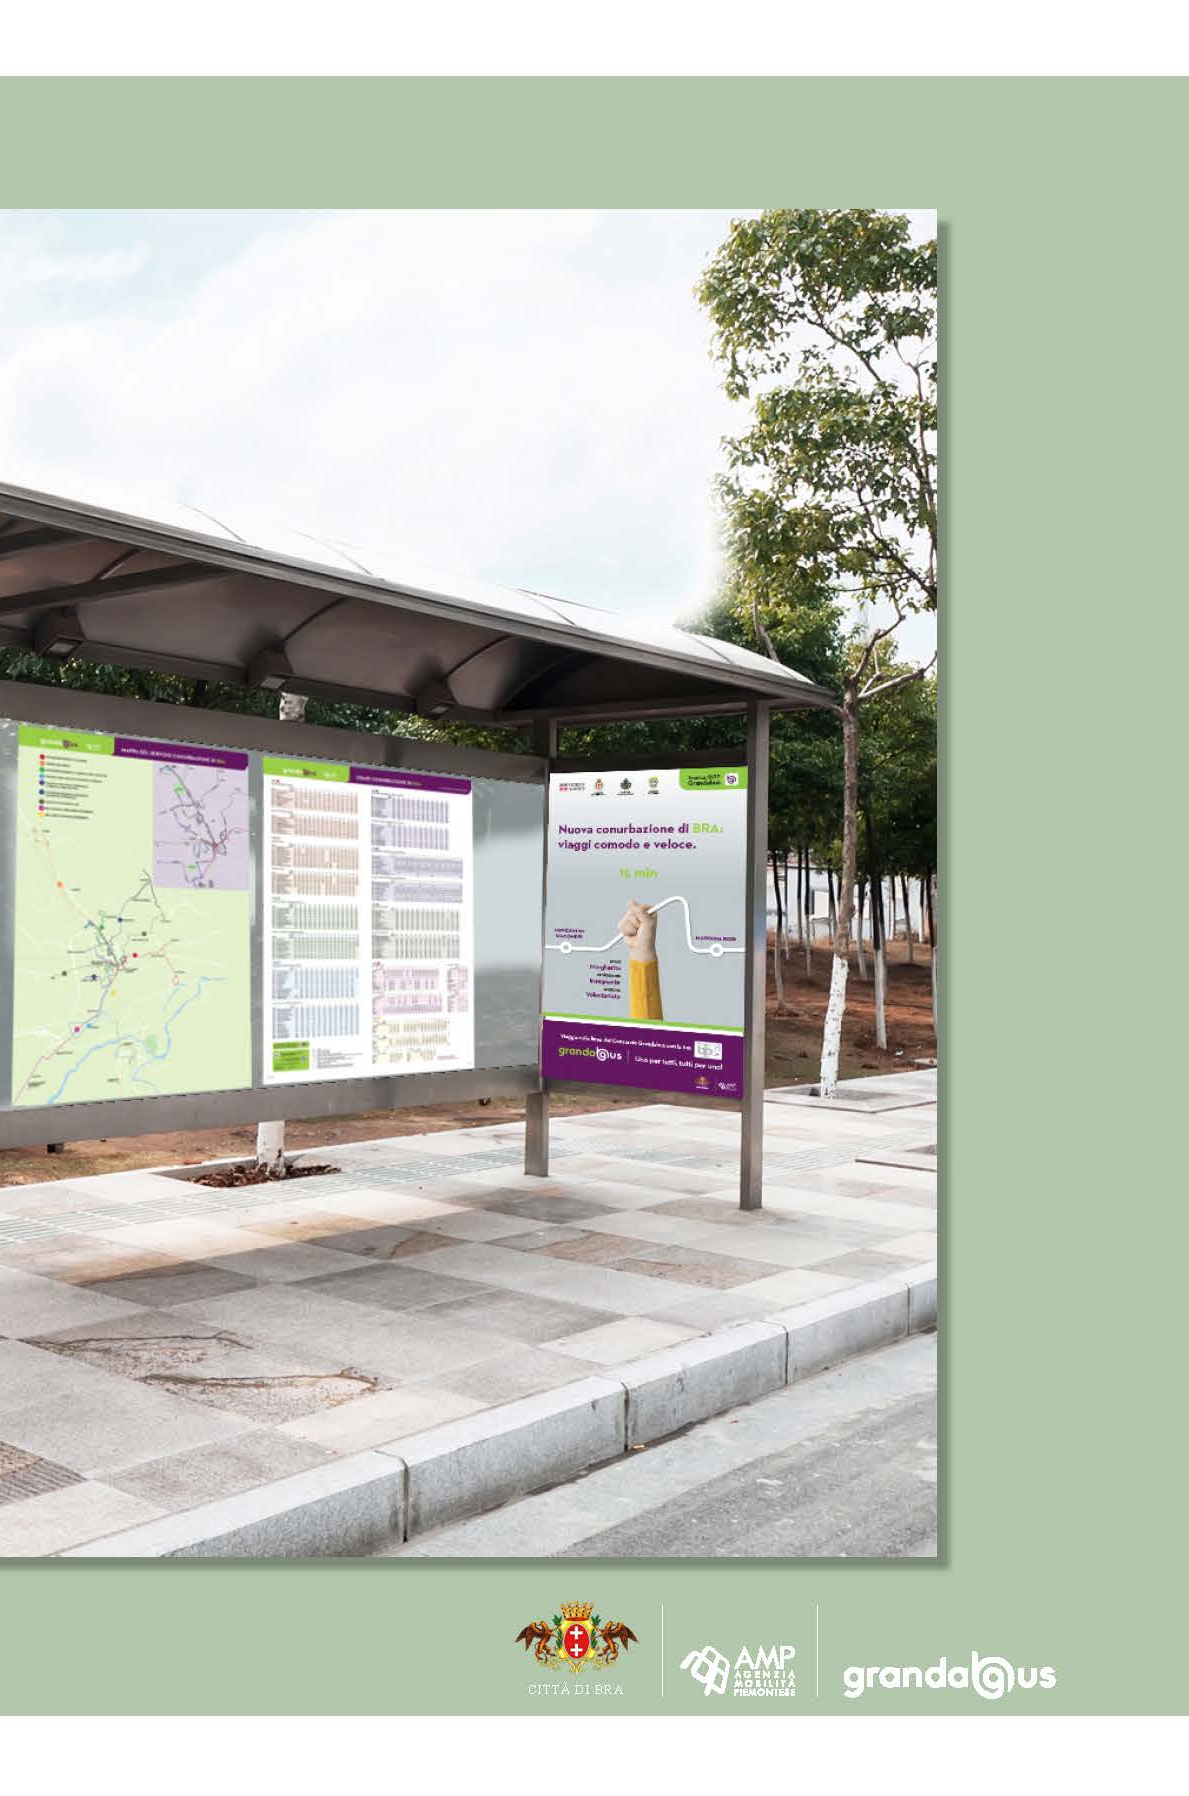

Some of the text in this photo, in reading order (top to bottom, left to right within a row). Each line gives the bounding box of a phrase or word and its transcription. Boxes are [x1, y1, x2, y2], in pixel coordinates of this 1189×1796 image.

[558, 821, 724, 835] Nuova conurbazione di BRA:
[558, 838, 697, 851] viaggi comodo e veloce.
[634, 866, 659, 879] min
